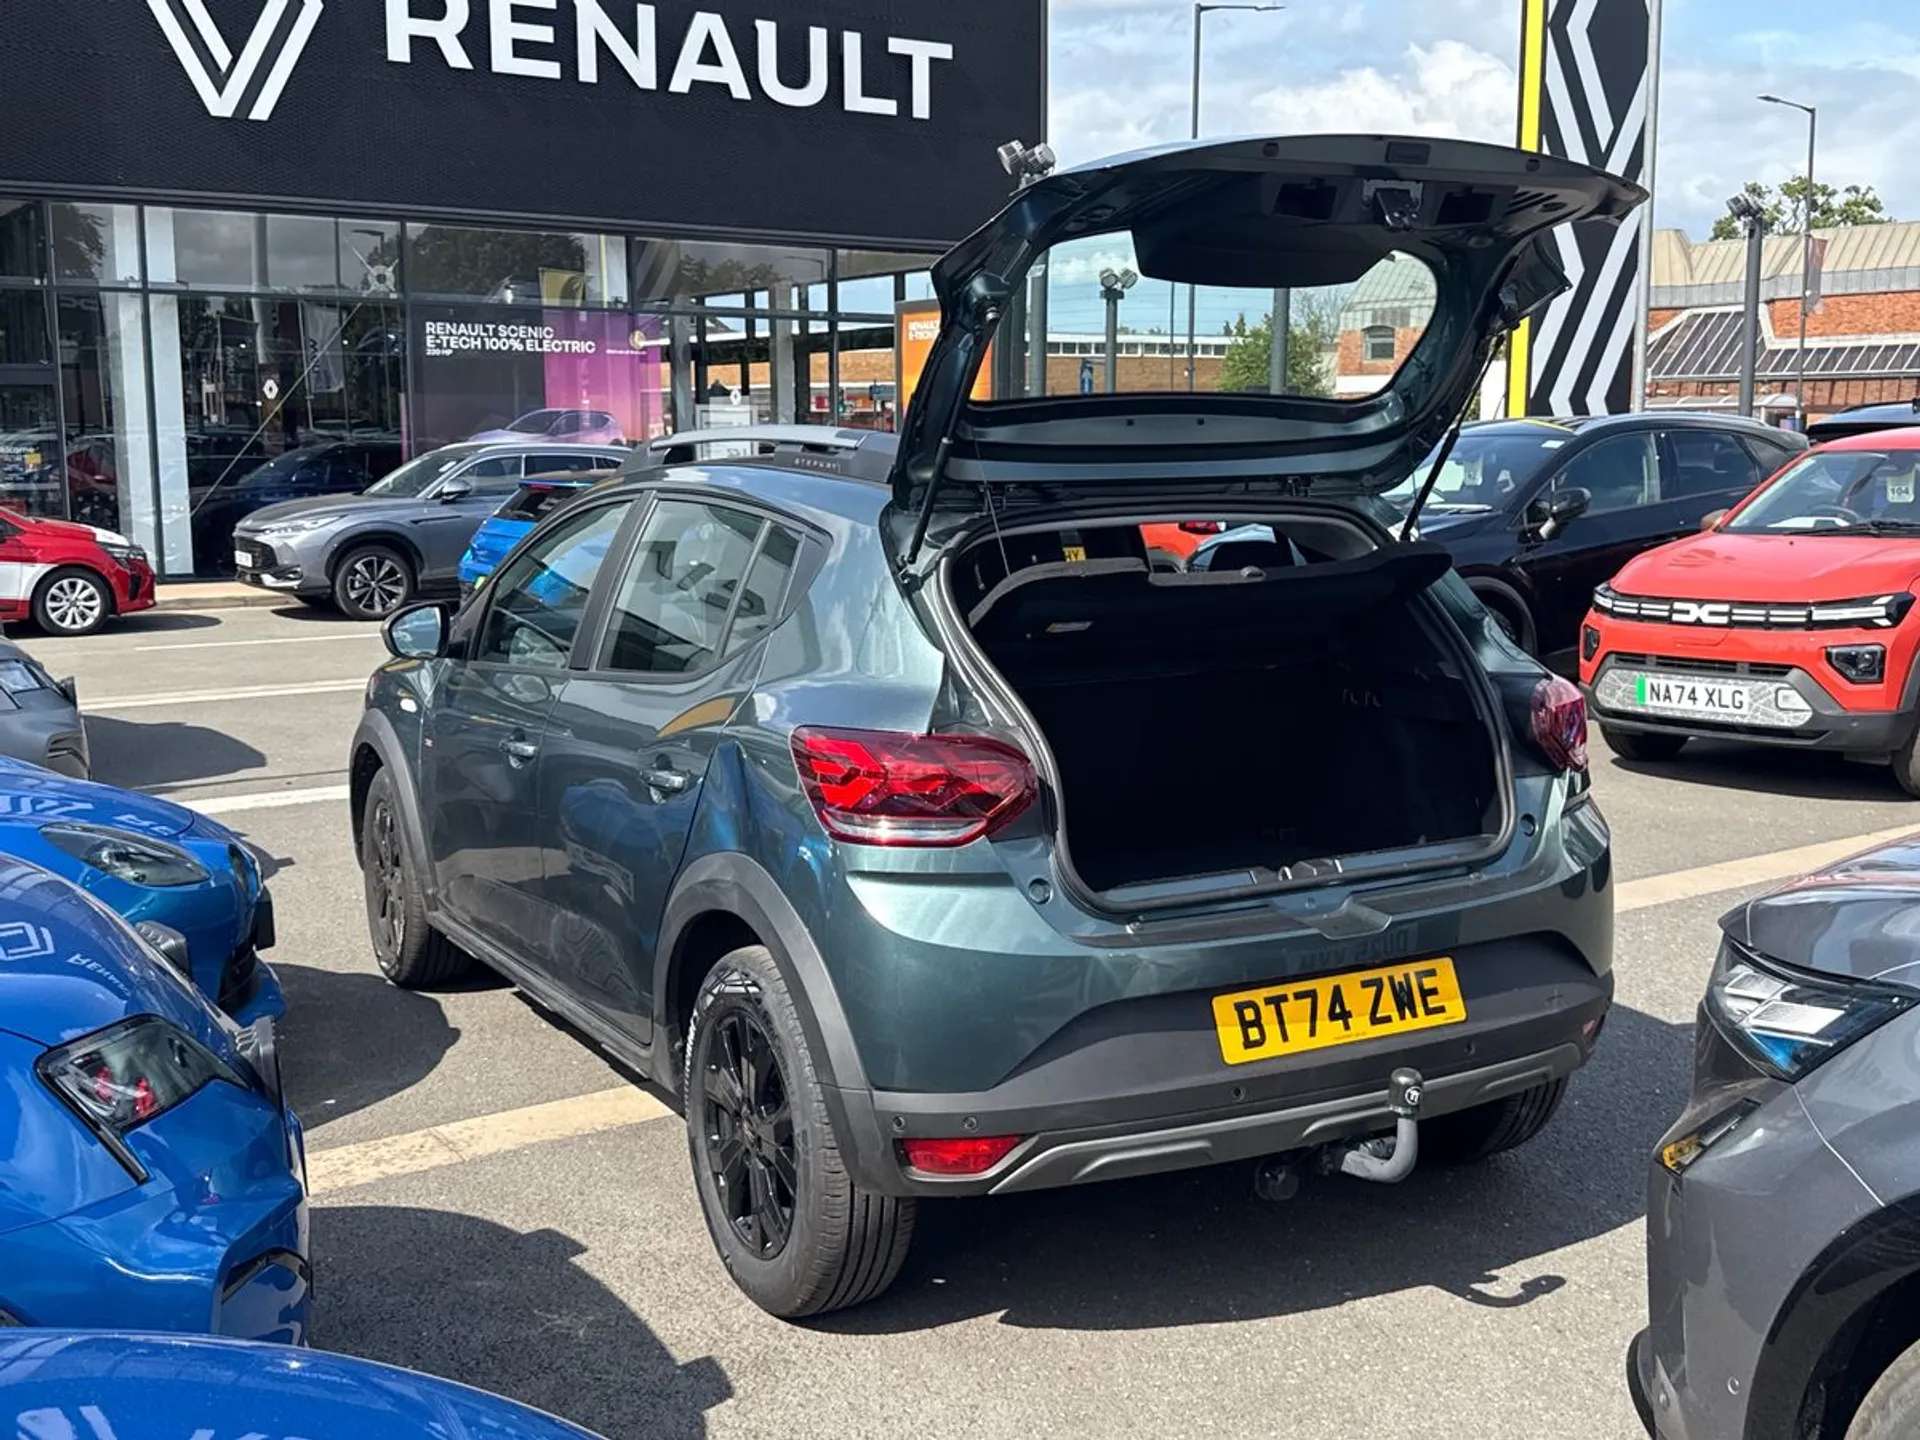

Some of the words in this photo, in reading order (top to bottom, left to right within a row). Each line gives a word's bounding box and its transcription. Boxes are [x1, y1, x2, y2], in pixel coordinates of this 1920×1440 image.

[386, 0, 953, 119] RENAULT
[425, 321, 496, 336] RENAULT
[498, 324, 554, 339] SCENIC
[426, 335, 481, 349] E-TECH
[483, 337, 524, 351] 100%
[526, 339, 596, 354] ELECTRIC
[1650, 682, 1698, 705] NA74
[1705, 687, 1743, 709] XLG
[1233, 983, 1353, 1051] BT74
[1360, 967, 1447, 1027] ZWE
